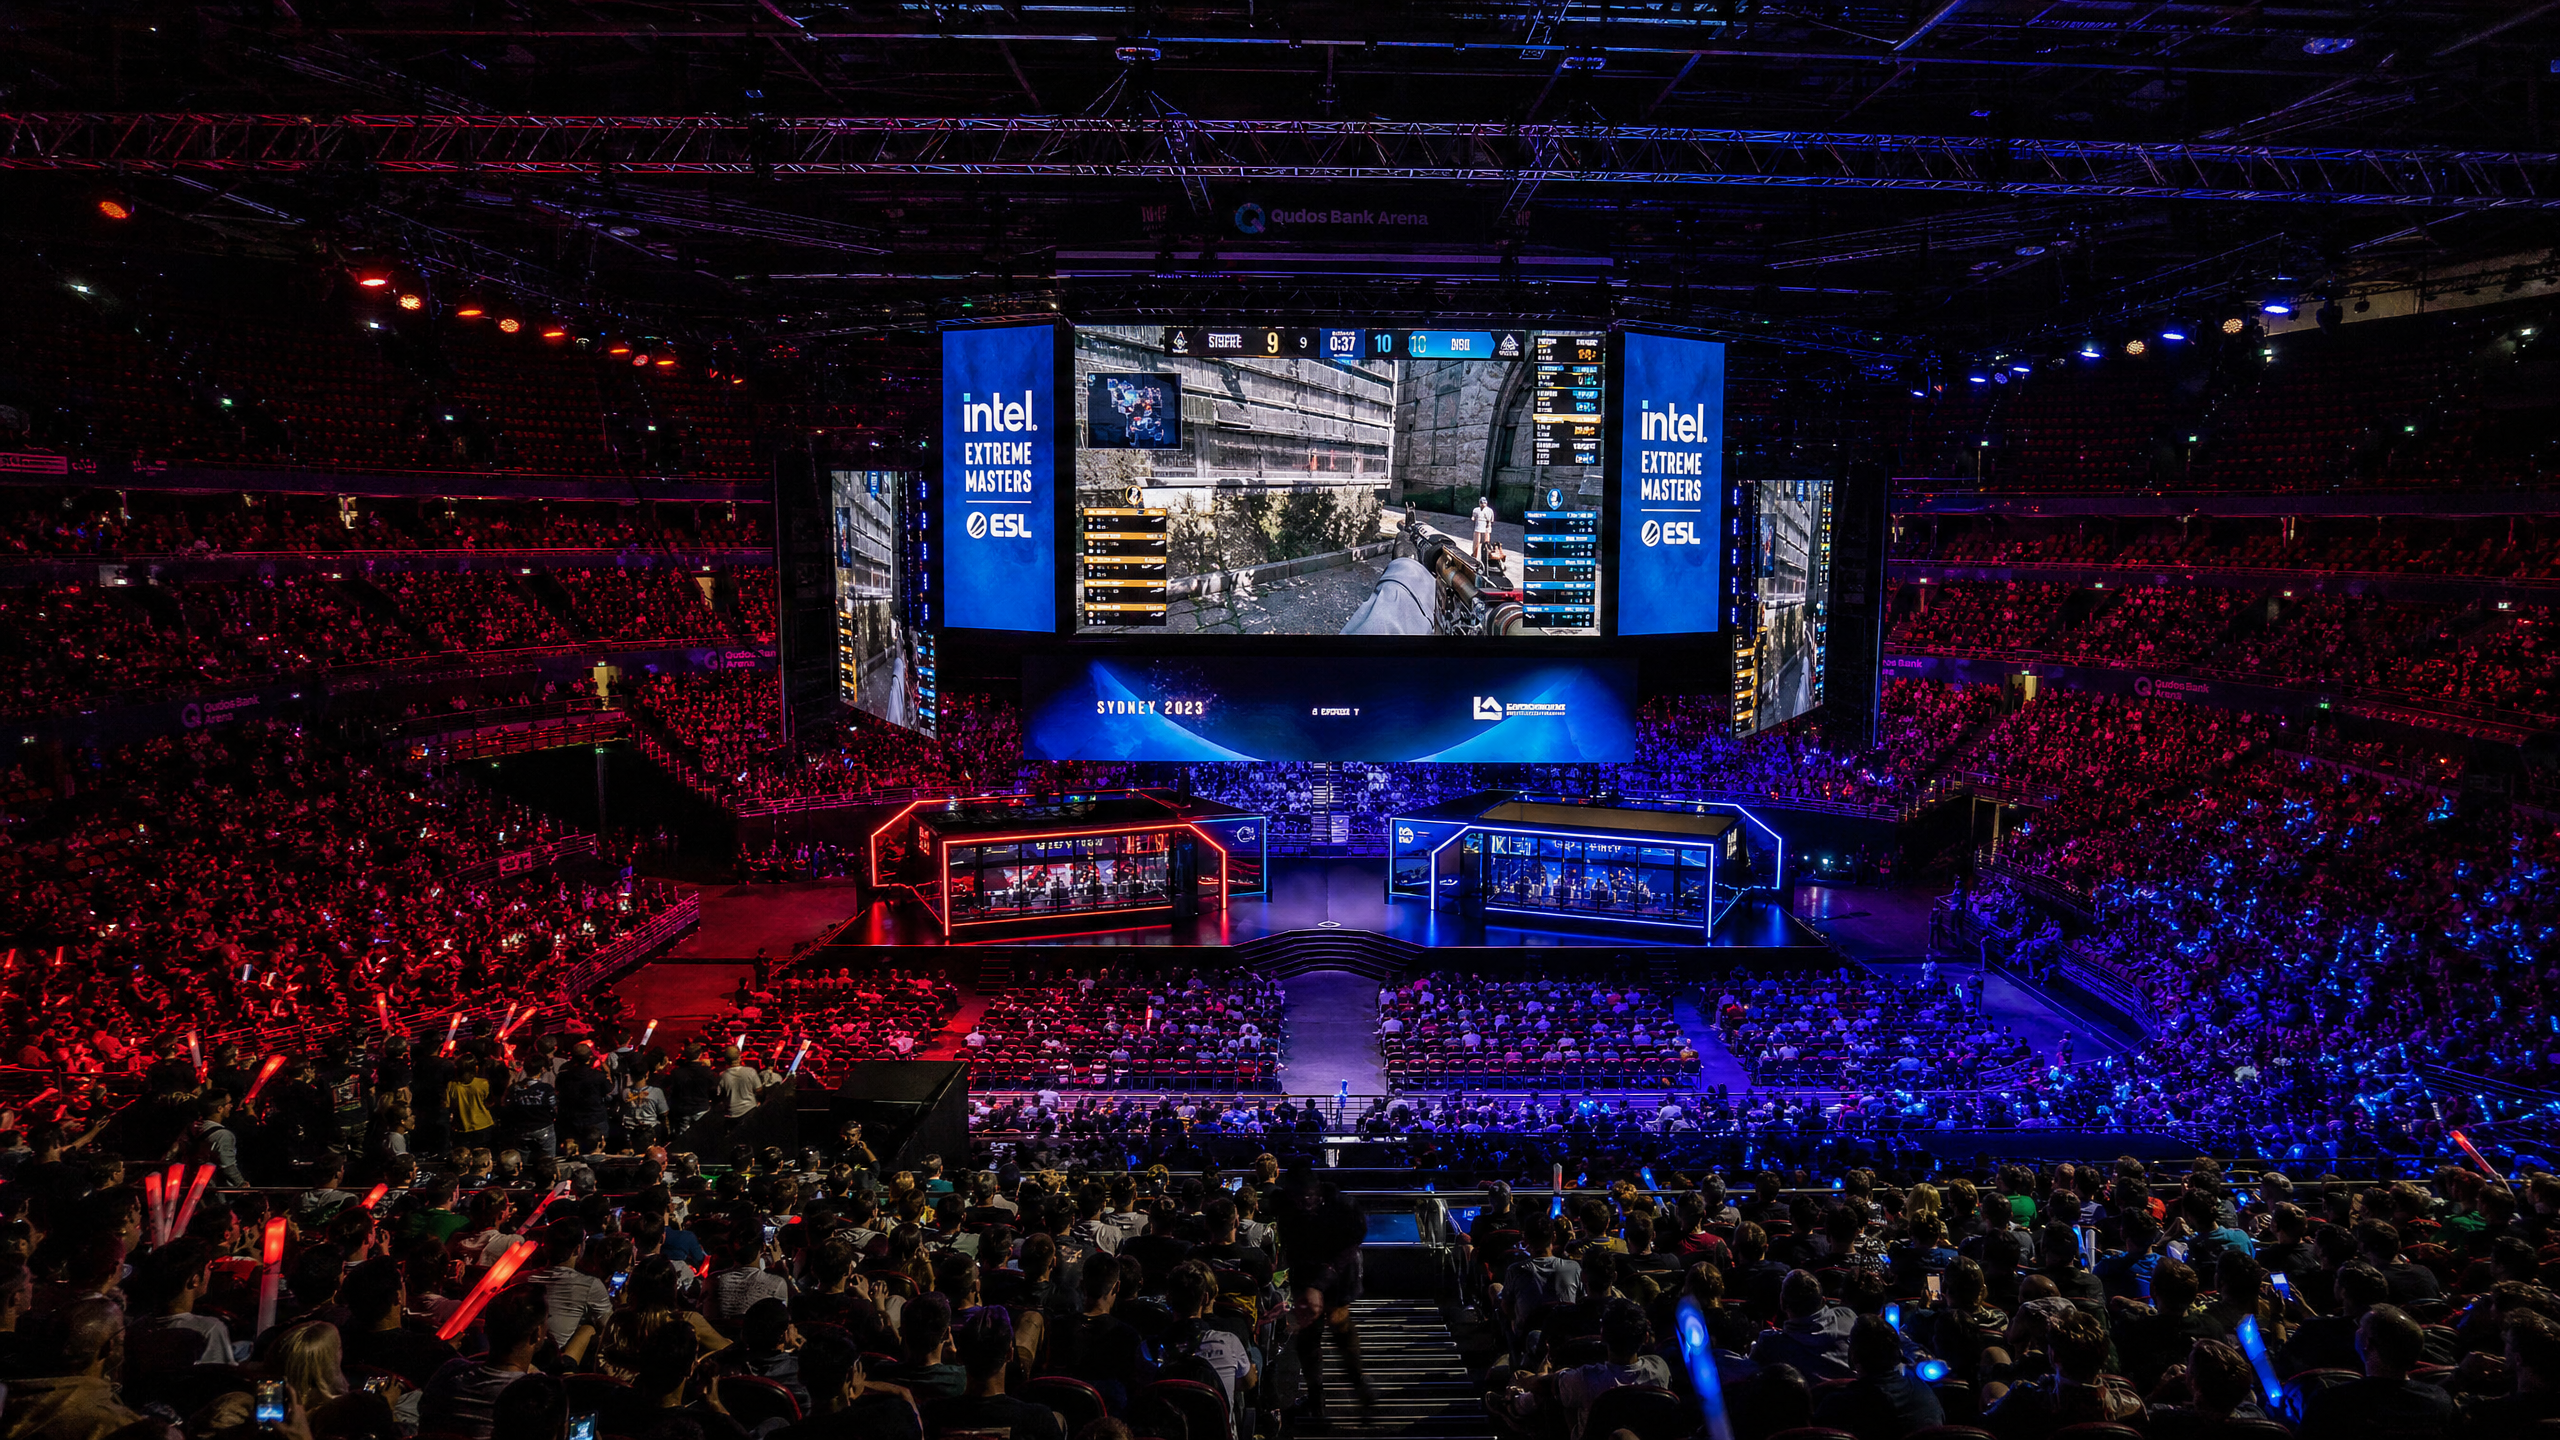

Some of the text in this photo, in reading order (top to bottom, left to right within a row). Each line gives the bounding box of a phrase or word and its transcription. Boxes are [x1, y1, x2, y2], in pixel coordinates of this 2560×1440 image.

[1271, 208, 1328, 225] Qudos
[1330, 209, 1375, 224] Bank
[1377, 210, 1429, 226] Arena
[1267, 332, 1279, 354] 9
[1299, 337, 1308, 349] 9
[1330, 336, 1356, 351] 0:37
[1374, 334, 1391, 353] 10
[965, 442, 1032, 465] EXTREME
[1641, 450, 1702, 475] EXTREME
[965, 469, 1032, 493] MASTERS
[1641, 478, 1702, 501] MASTERS
[990, 513, 1032, 538] ESL
[1662, 521, 1701, 545] ESL
[1097, 700, 1203, 715] SYDNEY 2023
